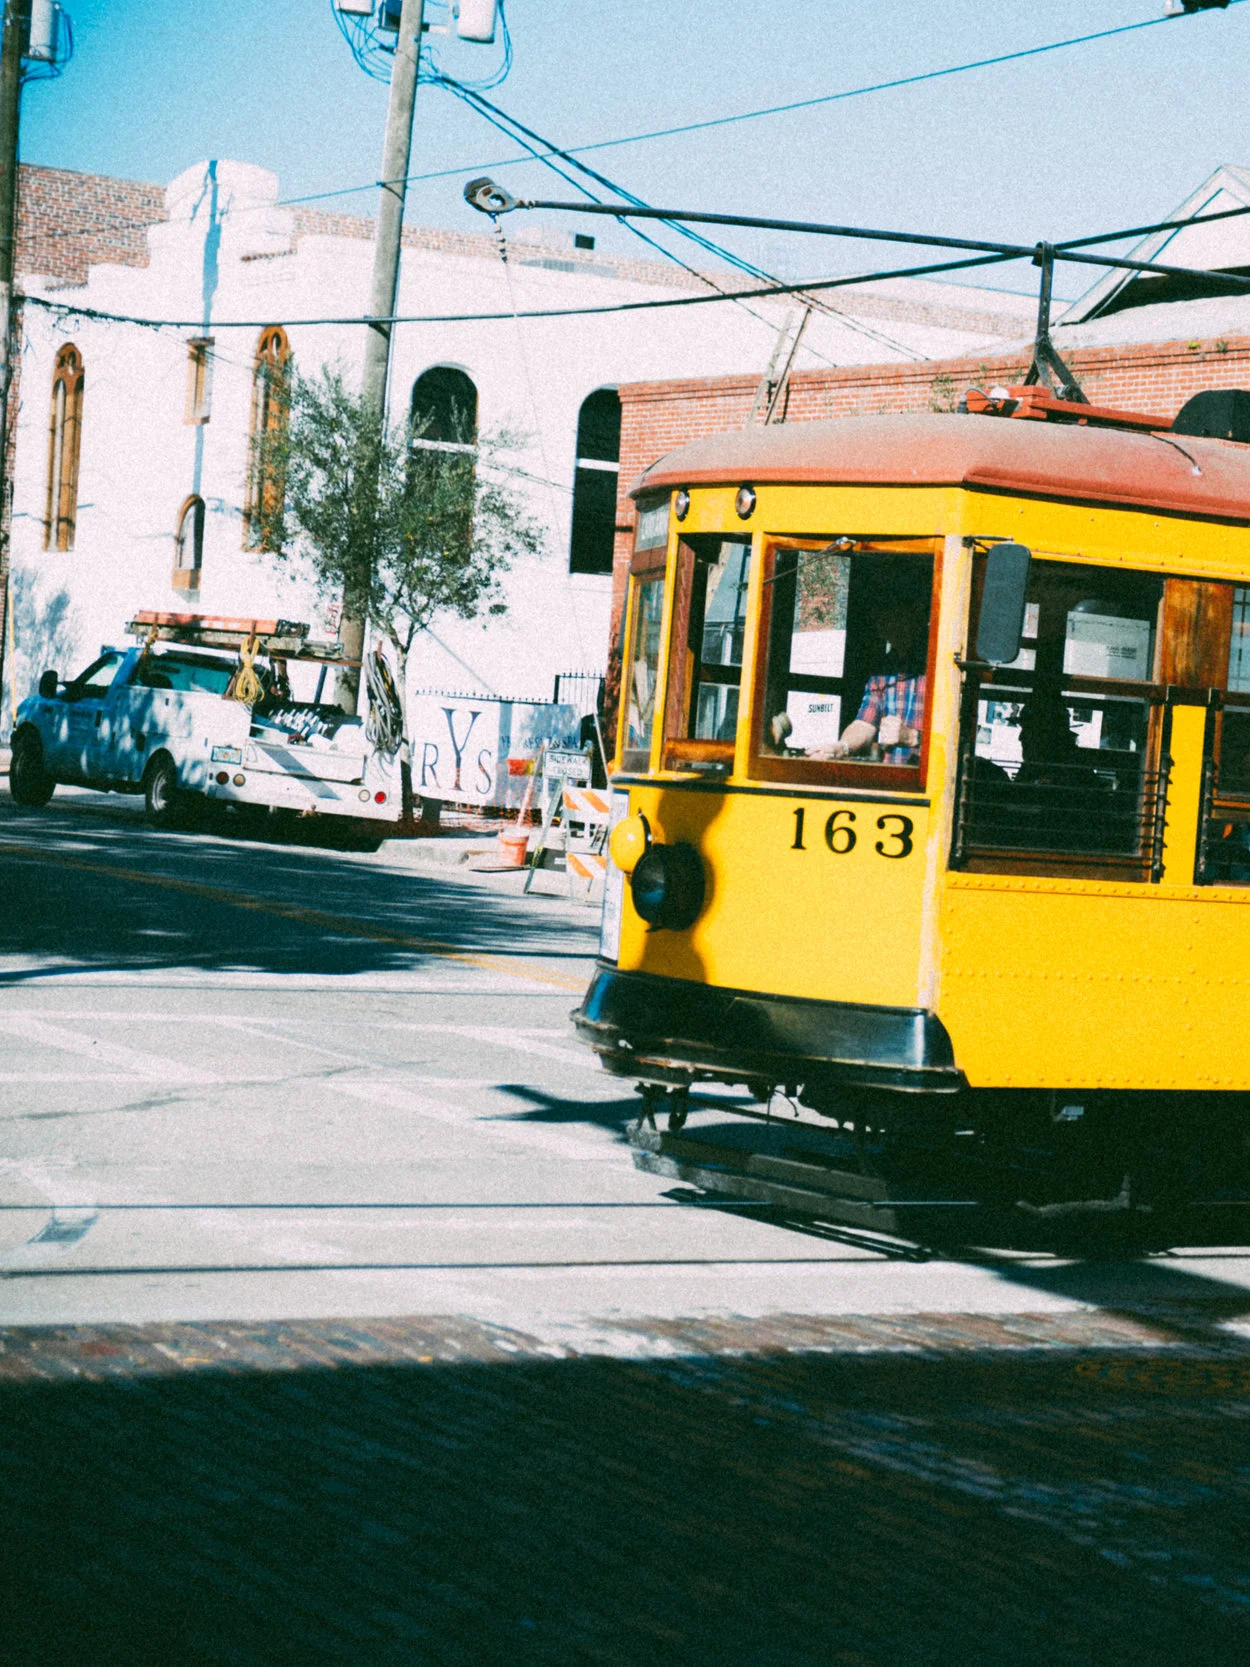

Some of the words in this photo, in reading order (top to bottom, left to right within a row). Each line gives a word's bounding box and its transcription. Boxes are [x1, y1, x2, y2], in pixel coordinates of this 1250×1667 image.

[808, 703, 833, 713] SUNBELT
[411, 707, 492, 794] RYS
[790, 807, 914, 859] 163
